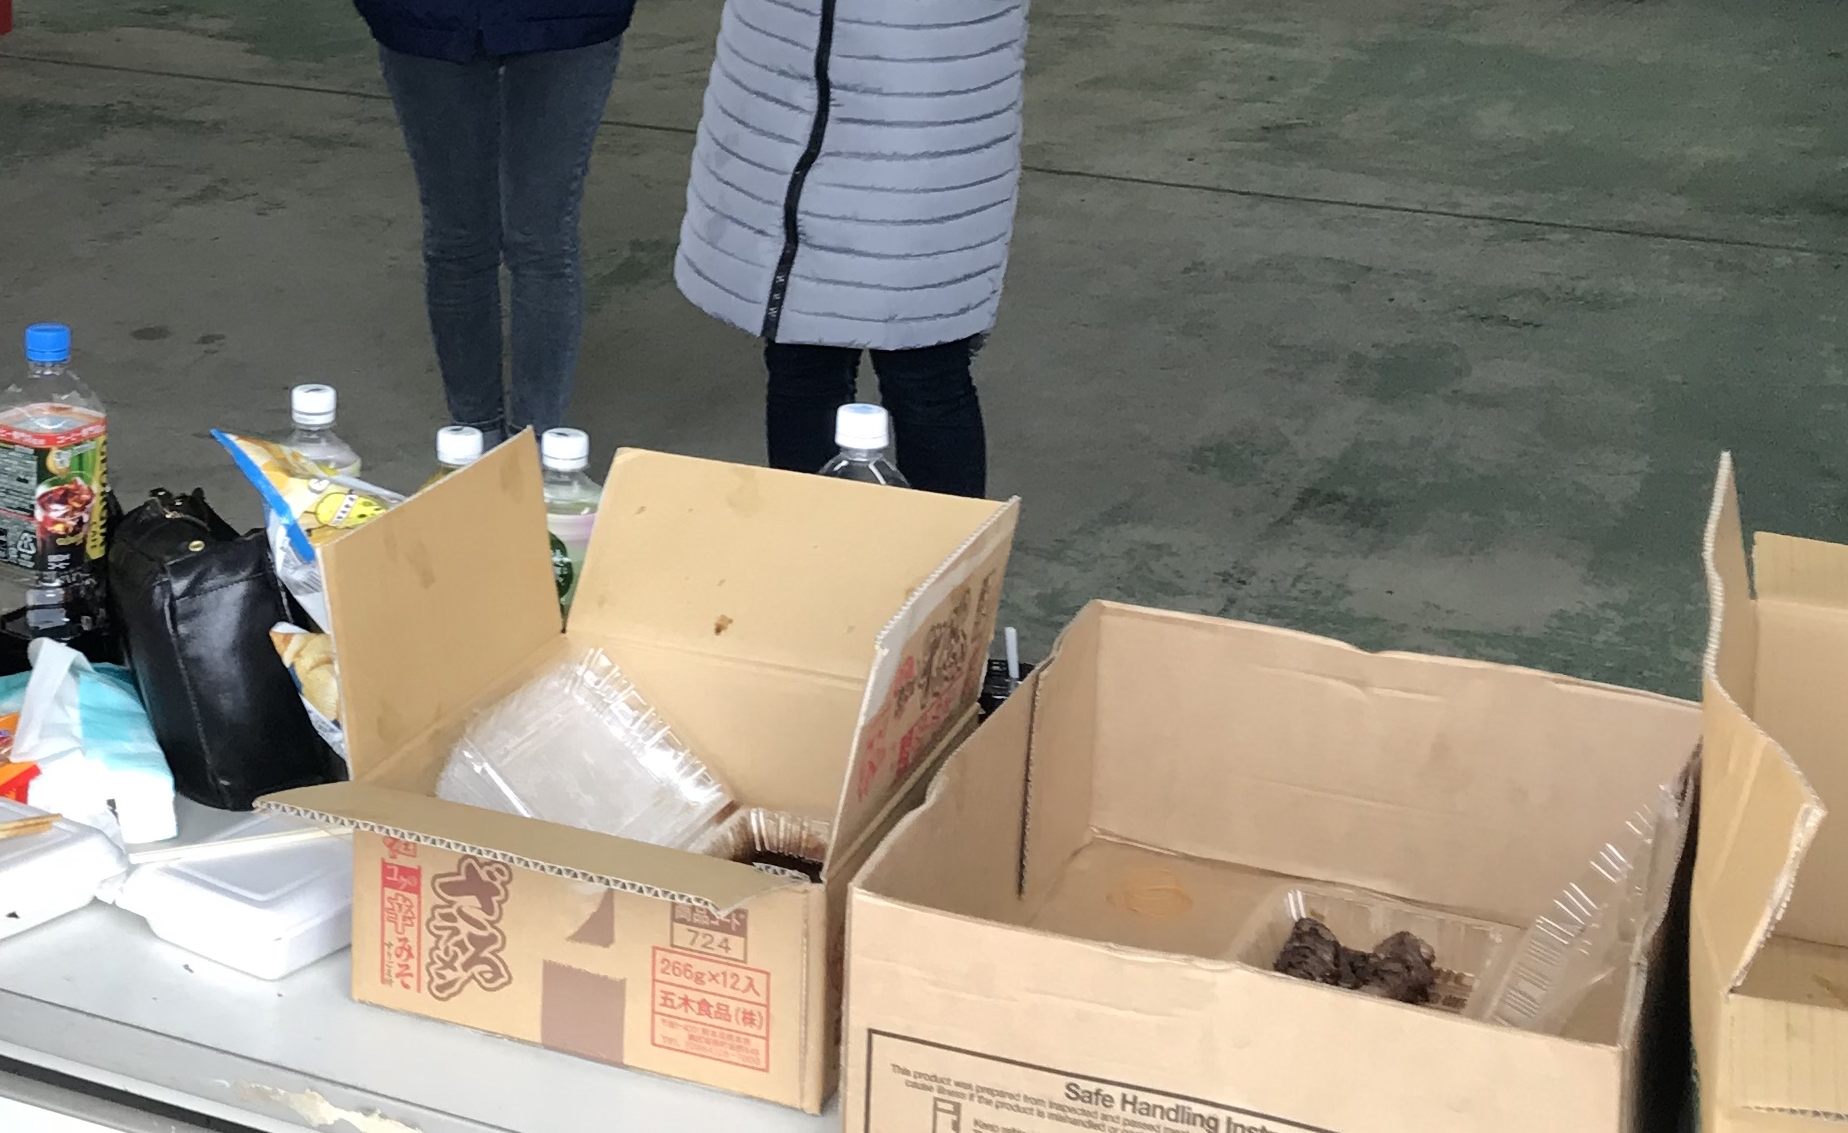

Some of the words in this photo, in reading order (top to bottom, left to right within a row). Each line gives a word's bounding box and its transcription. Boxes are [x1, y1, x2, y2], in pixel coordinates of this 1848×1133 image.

[687, 929, 732, 954] 724
[659, 990, 763, 1030] 五木食品(株)
[890, 1063, 911, 1077] This
[913, 1070, 952, 1086] product
[975, 1084, 1020, 1102] prepared
[1023, 1092, 1046, 1106] from
[1048, 1101, 1098, 1121] inspected
[1100, 1112, 1121, 1124] and
[904, 1079, 934, 1093] cause
[977, 1095, 994, 1106] the
[995, 1099, 1034, 1116] product
[1064, 1082, 1115, 1109] Safe
[1120, 1092, 1219, 1133] Handling
